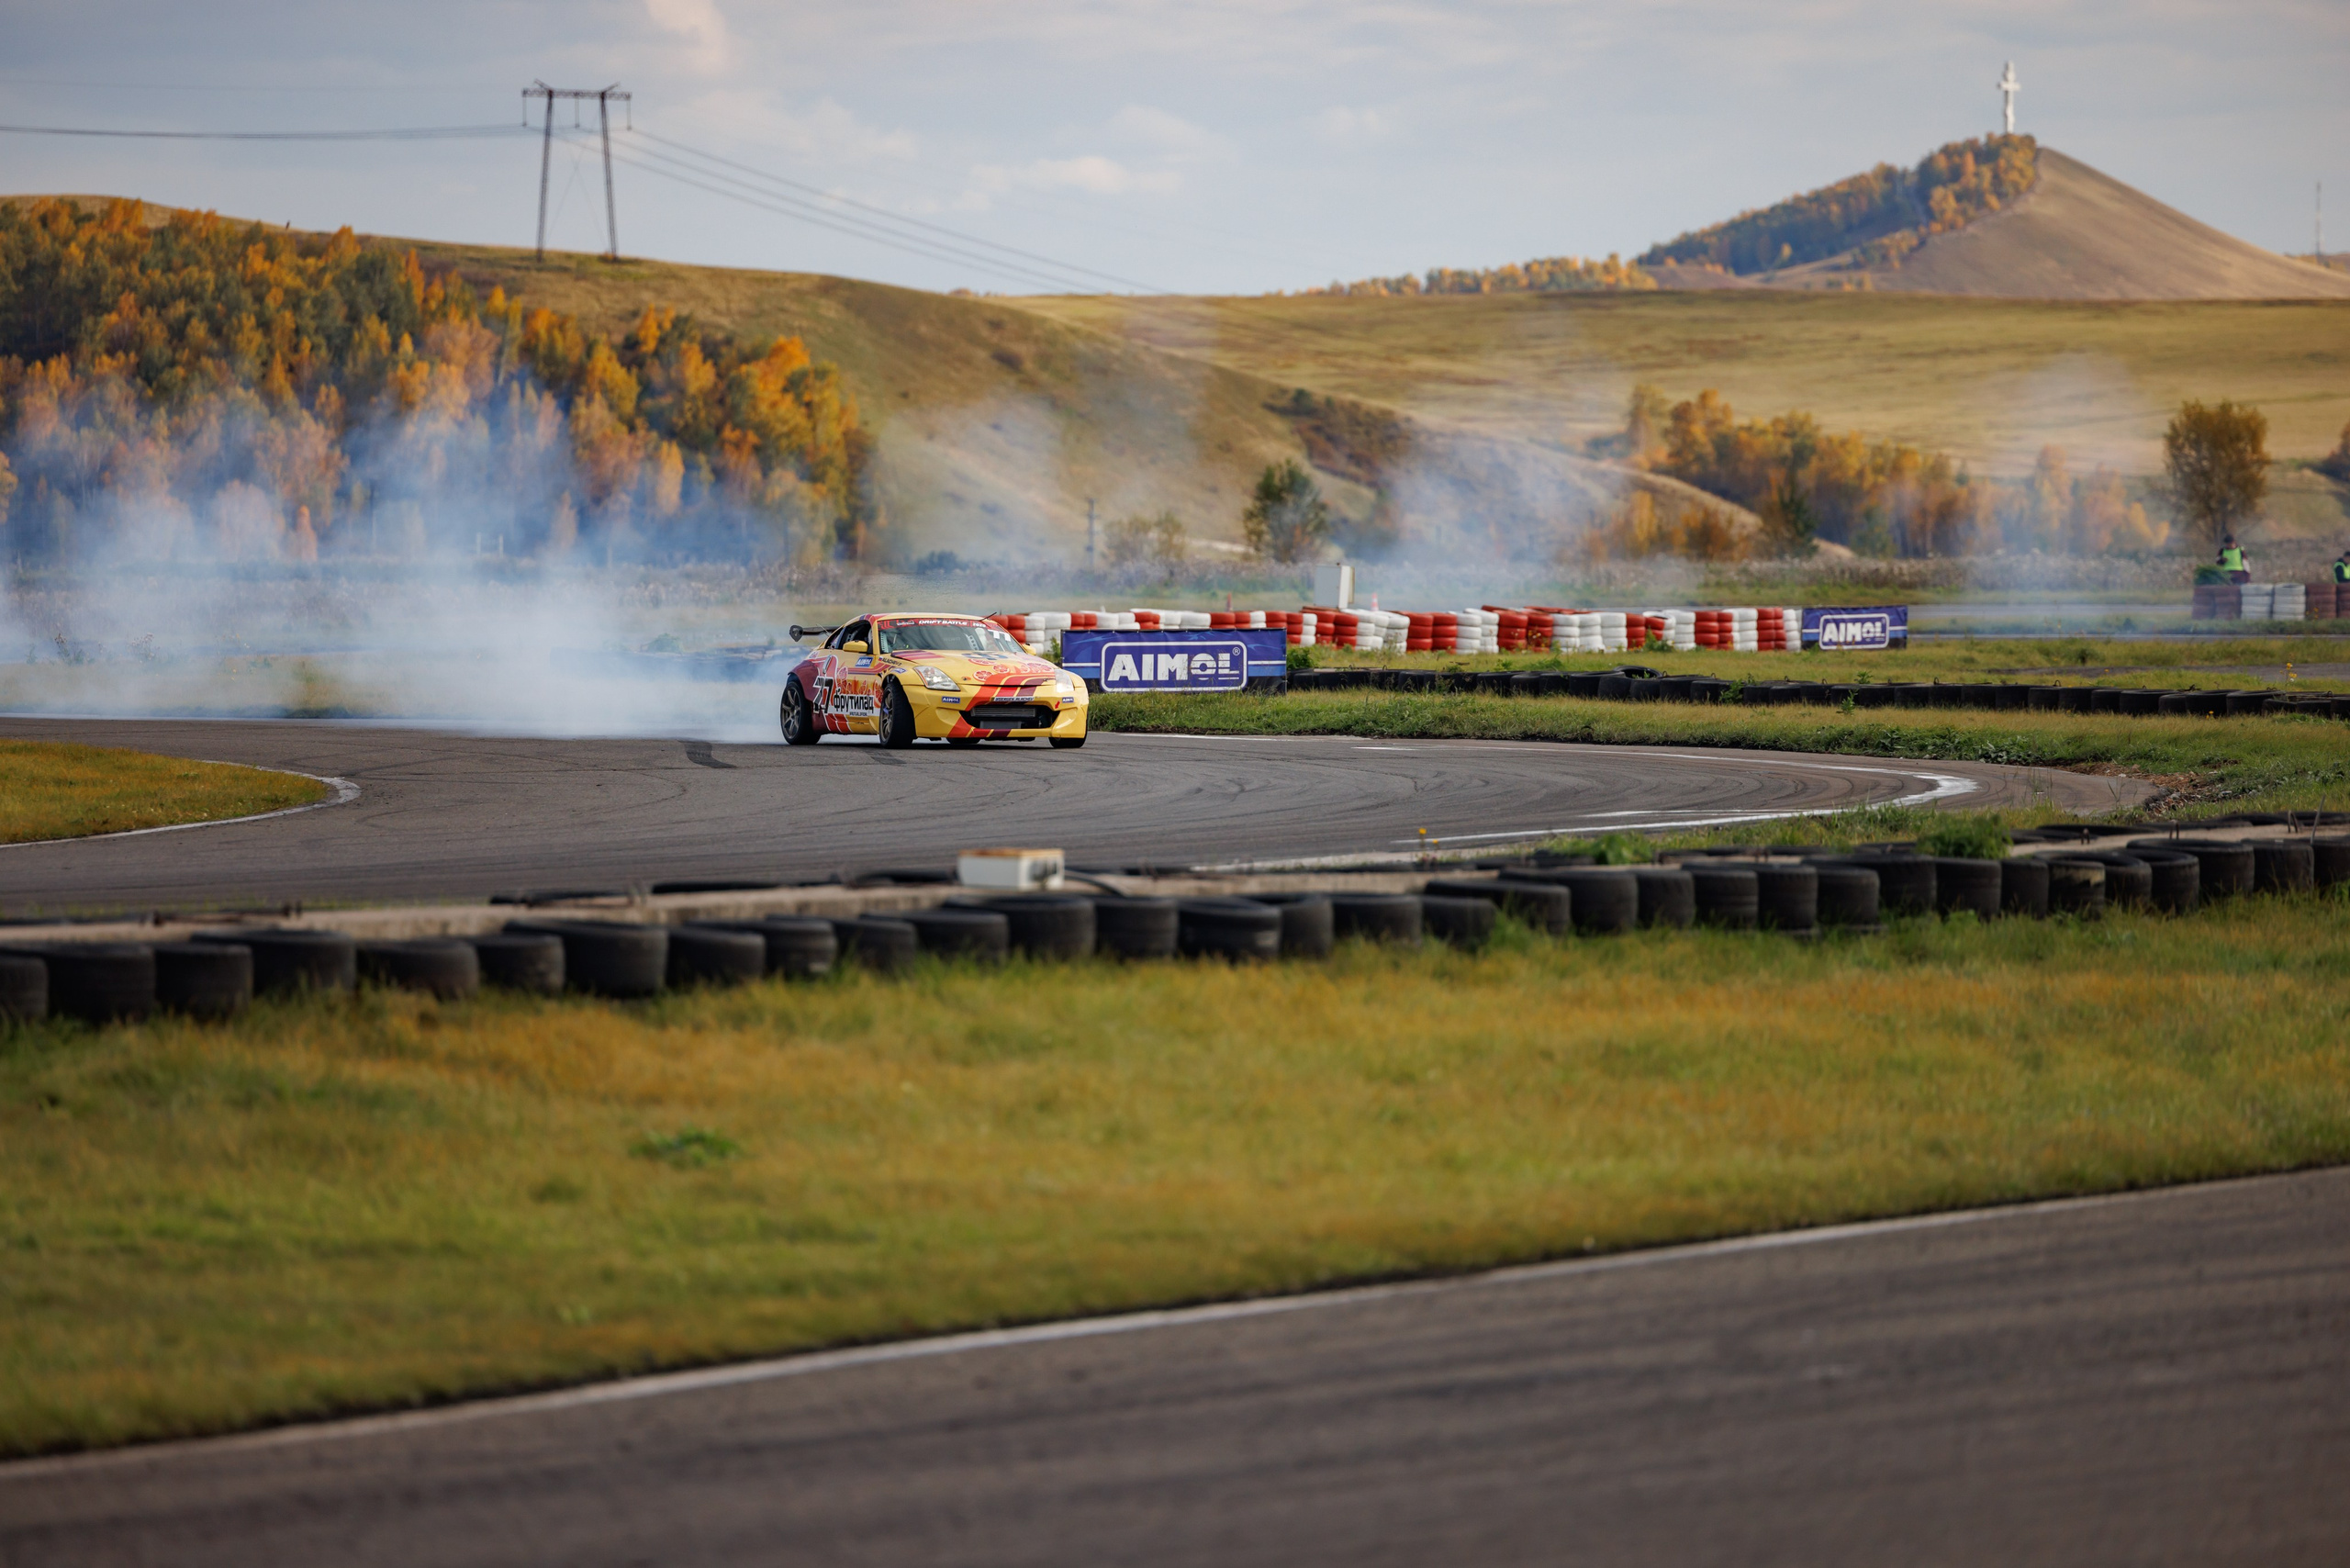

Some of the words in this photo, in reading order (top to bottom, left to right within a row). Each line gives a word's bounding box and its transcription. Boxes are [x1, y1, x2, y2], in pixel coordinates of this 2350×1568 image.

[1822, 622, 1886, 642] AIMOL
[1107, 653, 1239, 681] AIMOL
[813, 676, 834, 715] 77
